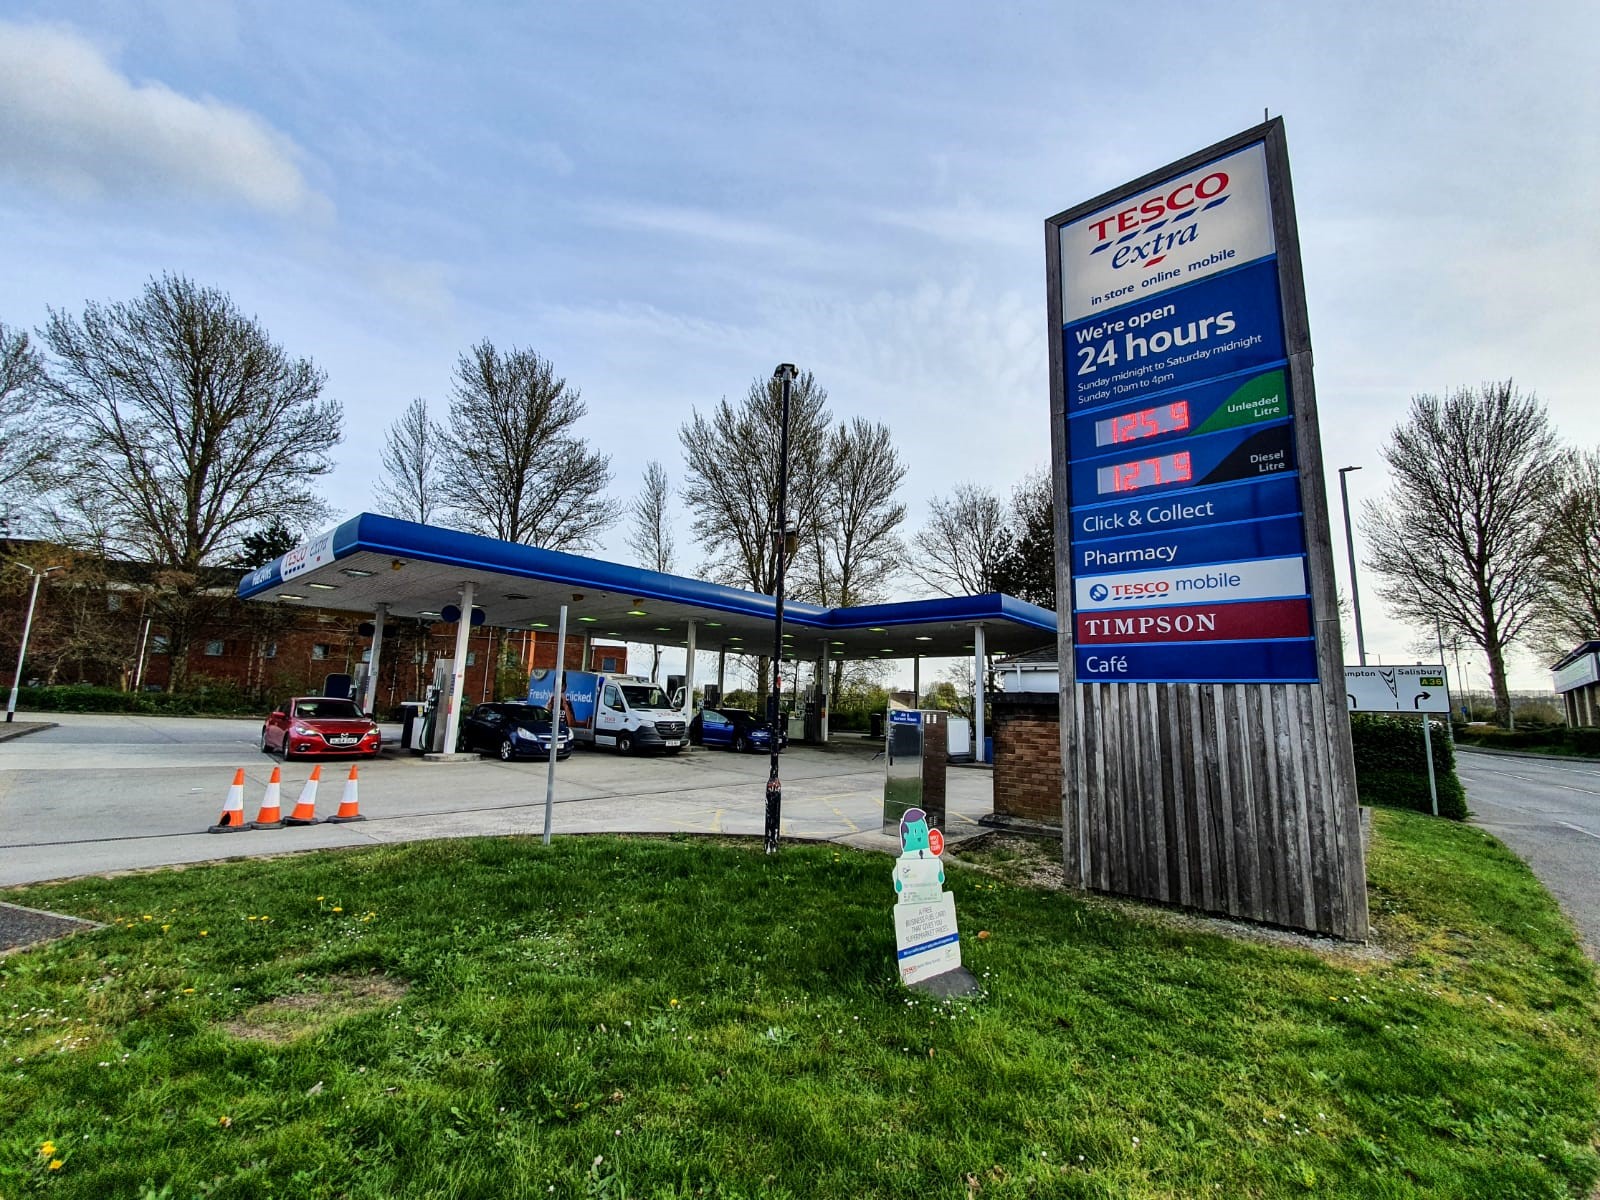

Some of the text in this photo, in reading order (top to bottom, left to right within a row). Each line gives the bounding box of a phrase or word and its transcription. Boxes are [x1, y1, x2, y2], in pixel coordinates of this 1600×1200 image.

[1088, 172, 1230, 242] TESCO
[1112, 222, 1198, 270] extra
[1091, 248, 1236, 306] in store online mobile
[1076, 303, 1176, 344] We're open
[1077, 310, 1236, 376] 24 hours
[1078, 334, 1262, 392] Sunday midnight to Saturday midnight
[1078, 372, 1174, 404] Sunday 10am to 4pm
[1227, 394, 1279, 413] Unleaded
[1112, 400, 1190, 444] 125.9
[1254, 405, 1280, 418] Litre
[1114, 451, 1192, 492] 127.9
[1250, 450, 1284, 464] Diesel
[1258, 460, 1286, 473] Litre
[1083, 501, 1215, 532] Click & Collect
[1084, 545, 1178, 567] Pharmacy
[1112, 572, 1241, 596] TESCO mobile
[1085, 613, 1216, 636] TIMPSON
[1086, 656, 1128, 673] Café
